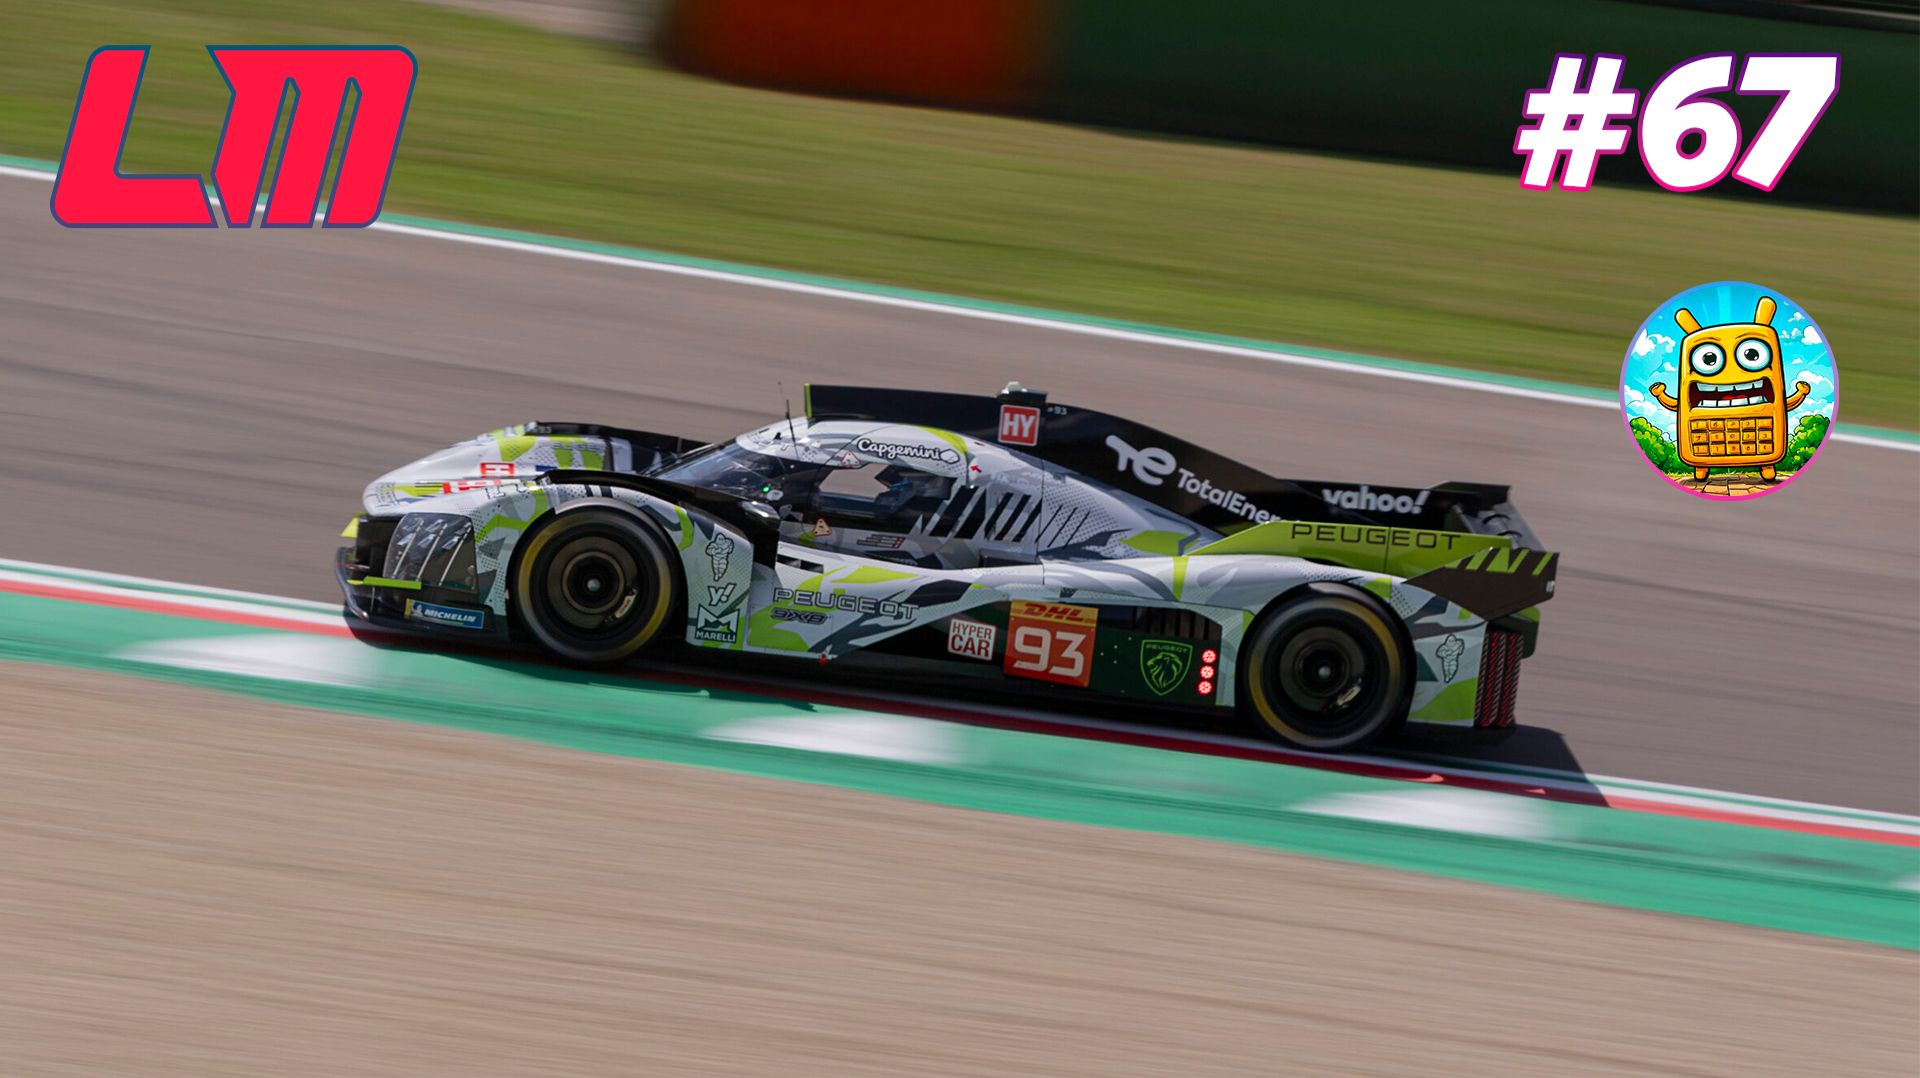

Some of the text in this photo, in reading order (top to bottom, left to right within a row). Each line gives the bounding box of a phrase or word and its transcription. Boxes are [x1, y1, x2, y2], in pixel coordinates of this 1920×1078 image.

[1002, 412, 1036, 438] HY
[857, 438, 941, 460] Capgemini
[1291, 523, 1461, 550] PEUGEOT
[773, 587, 920, 620] PEUGEOT
[1023, 602, 1084, 622] DHL
[424, 608, 476, 623] MICHELIN
[696, 630, 736, 642] MARELLI
[952, 621, 993, 640] HYPER
[951, 634, 991, 657] CAR
[1013, 625, 1087, 678] 93
